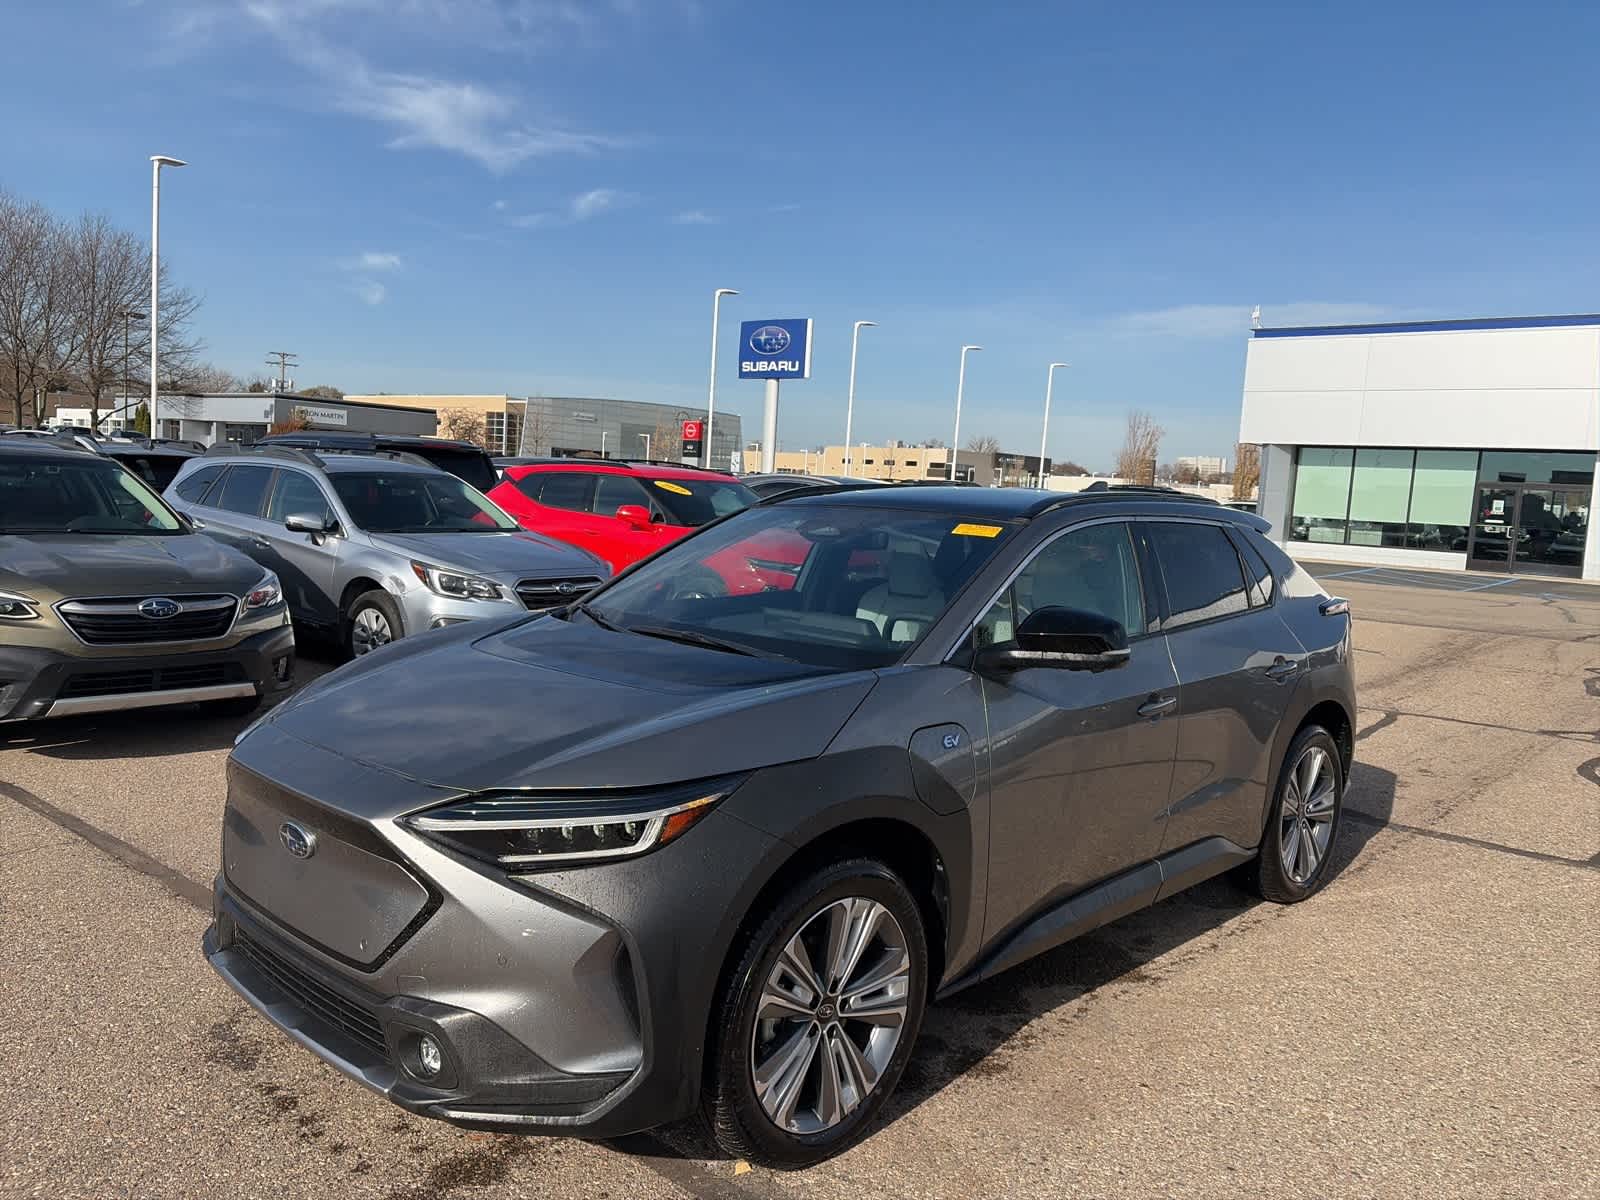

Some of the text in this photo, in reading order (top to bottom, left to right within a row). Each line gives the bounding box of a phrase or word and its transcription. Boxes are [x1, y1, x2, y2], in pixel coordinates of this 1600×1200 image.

[742, 361, 799, 372] SUBARU
[320, 411, 344, 420] MARTIN
[944, 735, 960, 748] EV
